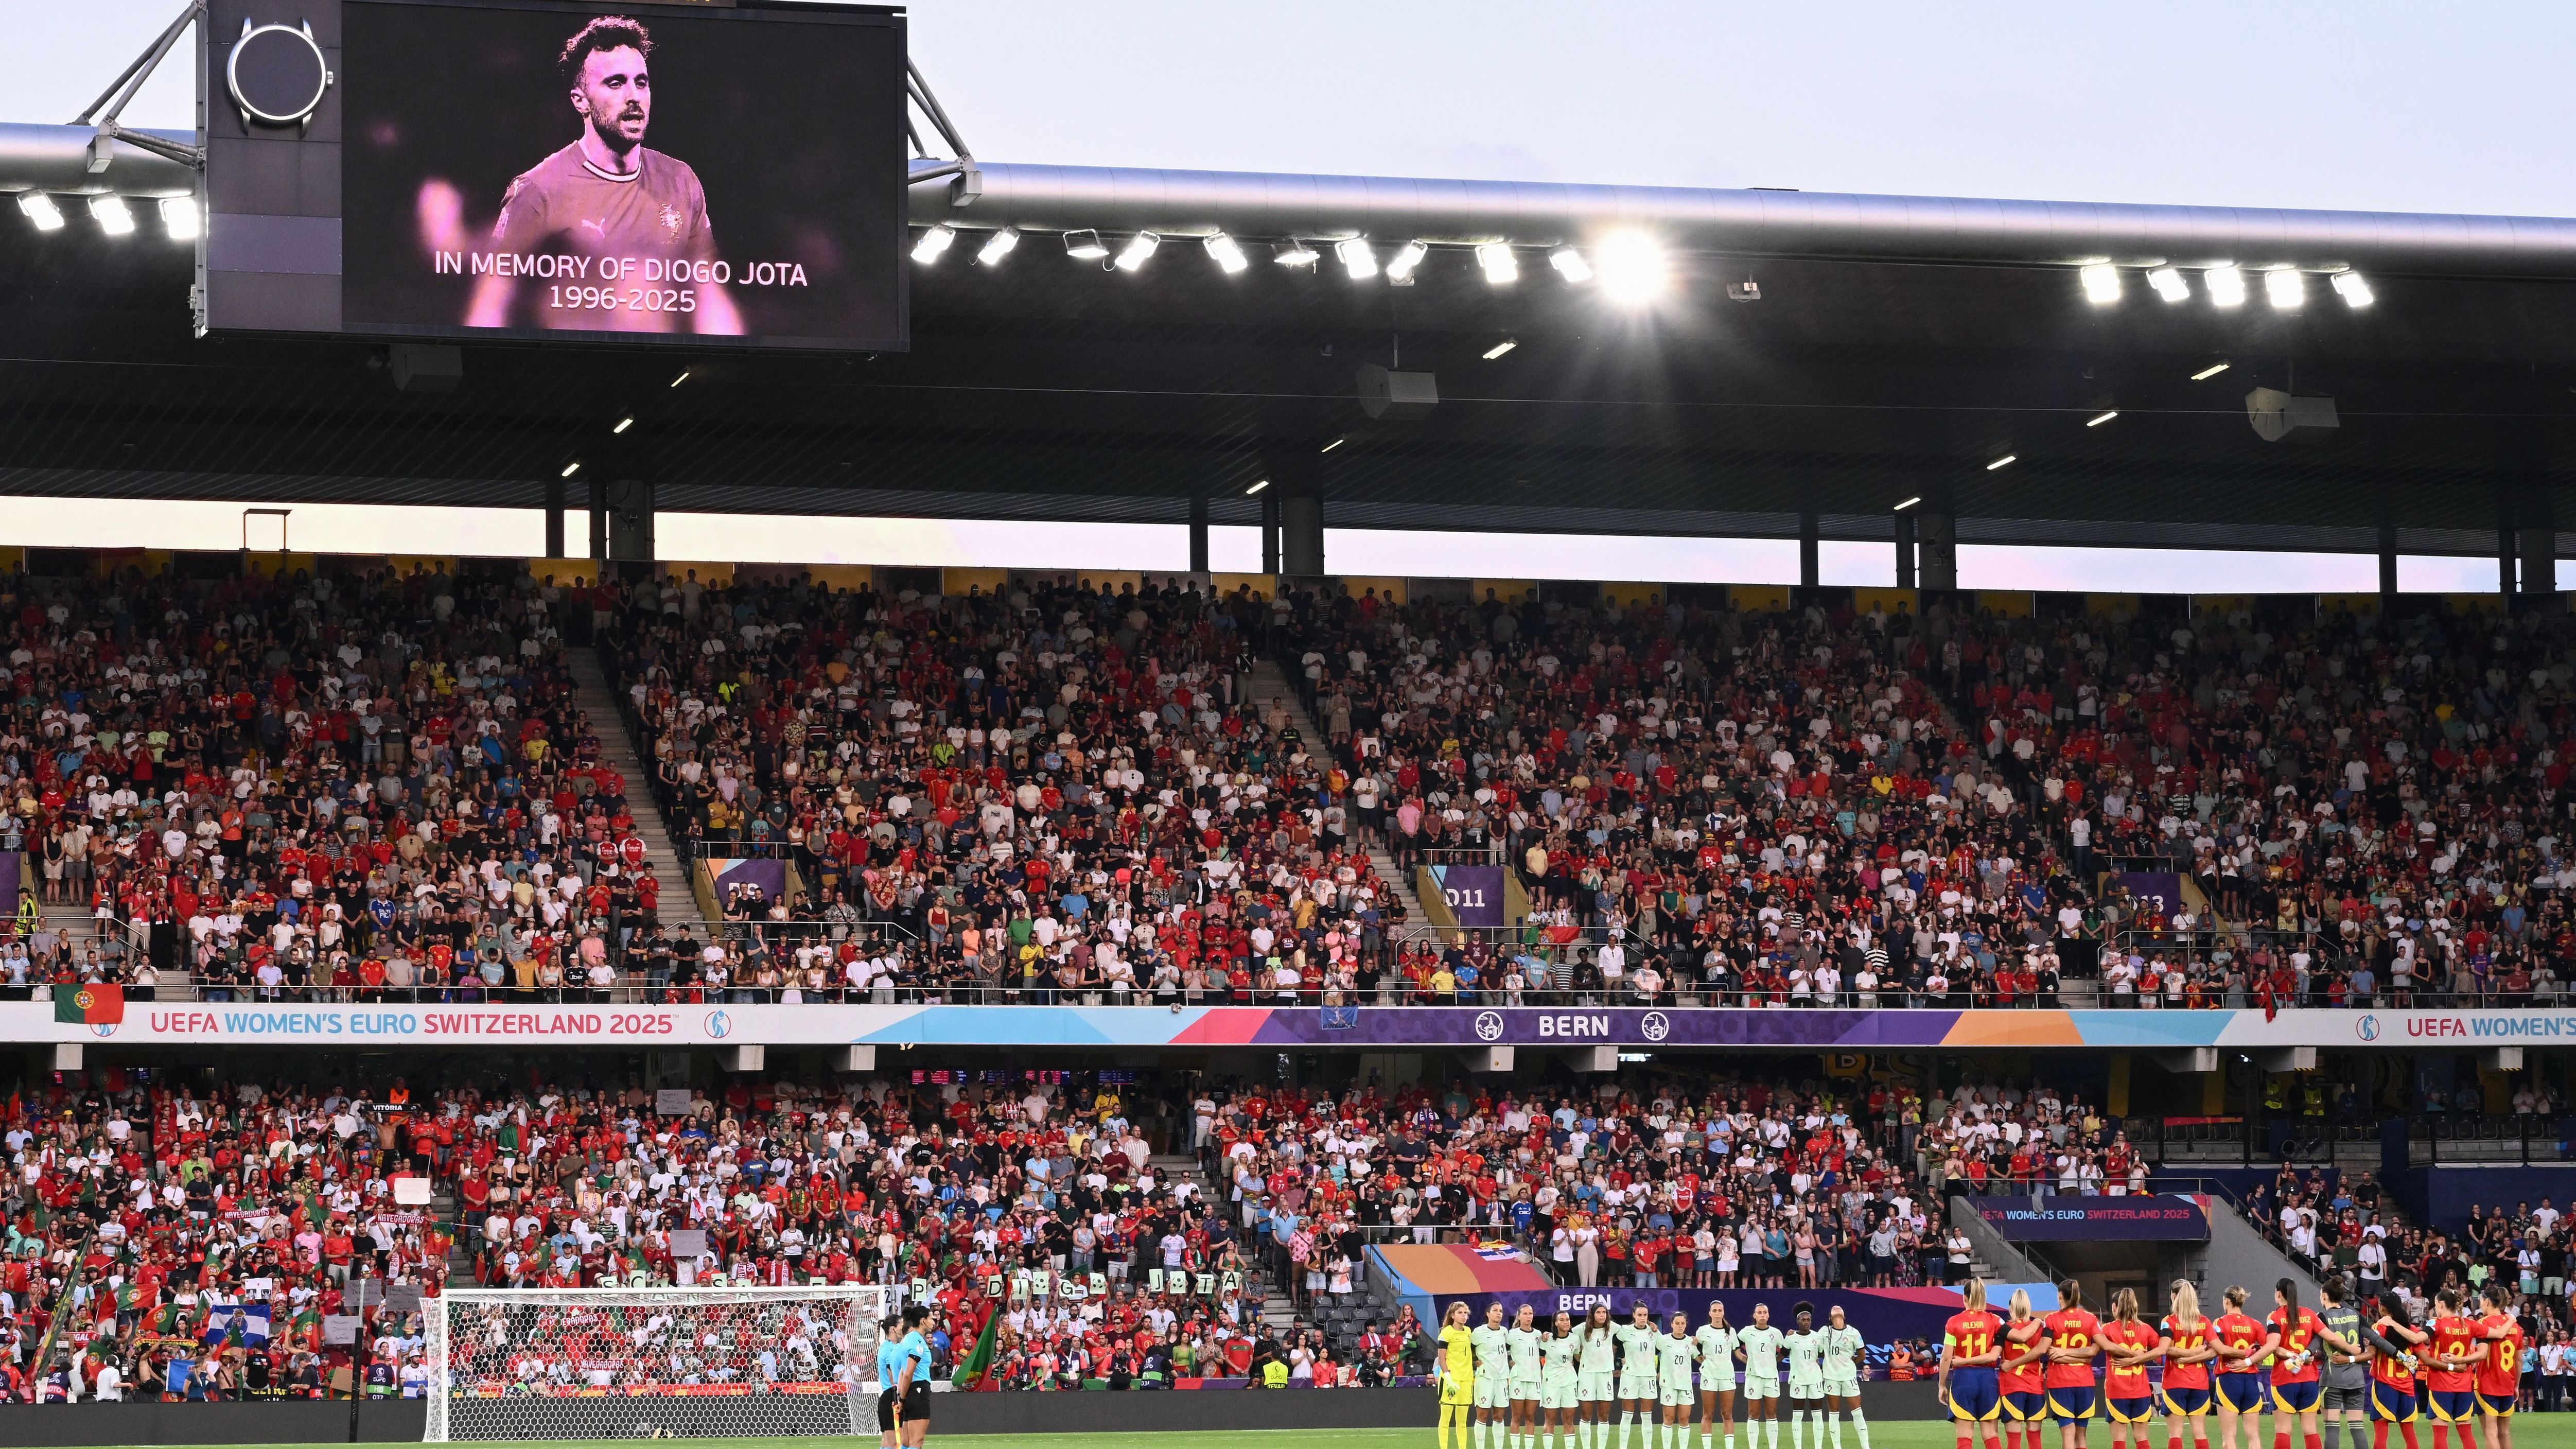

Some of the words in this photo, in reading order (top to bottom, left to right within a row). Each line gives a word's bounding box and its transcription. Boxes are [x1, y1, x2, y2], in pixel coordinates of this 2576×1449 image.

[436, 251, 462, 274] IN
[472, 252, 591, 278] MEMORY
[600, 257, 636, 280] OF
[645, 259, 730, 284] DIOGO
[739, 261, 807, 286] JOTA
[550, 286, 696, 312] 1996-2025
[1445, 888, 1485, 907] D11
[151, 1013, 219, 1033] UEFA
[224, 1014, 342, 1034] WOMEN'S
[351, 1014, 417, 1034] EURO
[424, 1014, 602, 1034] SWITZERLAND
[1539, 1016, 1608, 1036] BERN
[2408, 1018, 2467, 1037] UEFA
[2471, 1018, 2576, 1037] WOMEN'S
[377, 1213, 425, 1224] NAVEGADORAS
[2006, 1211, 2055, 1219] WOMEN'S
[2057, 1211, 2084, 1219] EURO
[2087, 1210, 2160, 1219] SWITZERLAND
[2163, 1210, 2190, 1219] 2025
[1559, 1294, 1611, 1311] BERN
[1962, 1321, 1984, 1329] ALEXIA
[2232, 1325, 2251, 1334] ESTHER
[1596, 1338, 1601, 1347] 6
[1640, 1342, 1648, 1351] 19
[1961, 1333, 1987, 1359] 11
[2289, 1330, 2306, 1353] 5
[1464, 1347, 1467, 1356] 1
[1498, 1344, 1504, 1354] 15
[1529, 1347, 1534, 1356] 11
[1715, 1345, 1723, 1354] 13
[1761, 1342, 1765, 1352] 2
[1831, 1346, 1839, 1355] 10
[1803, 1350, 1811, 1359] 17
[2175, 1336, 2204, 1369] 14
[2499, 1339, 2515, 1373] 8
[1562, 1354, 1566, 1363] 8
[1674, 1355, 1684, 1365] 20
[2012, 1343, 2030, 1376] 7
[1607, 1381, 1611, 1391] 6
[1649, 1380, 1655, 1390] 19
